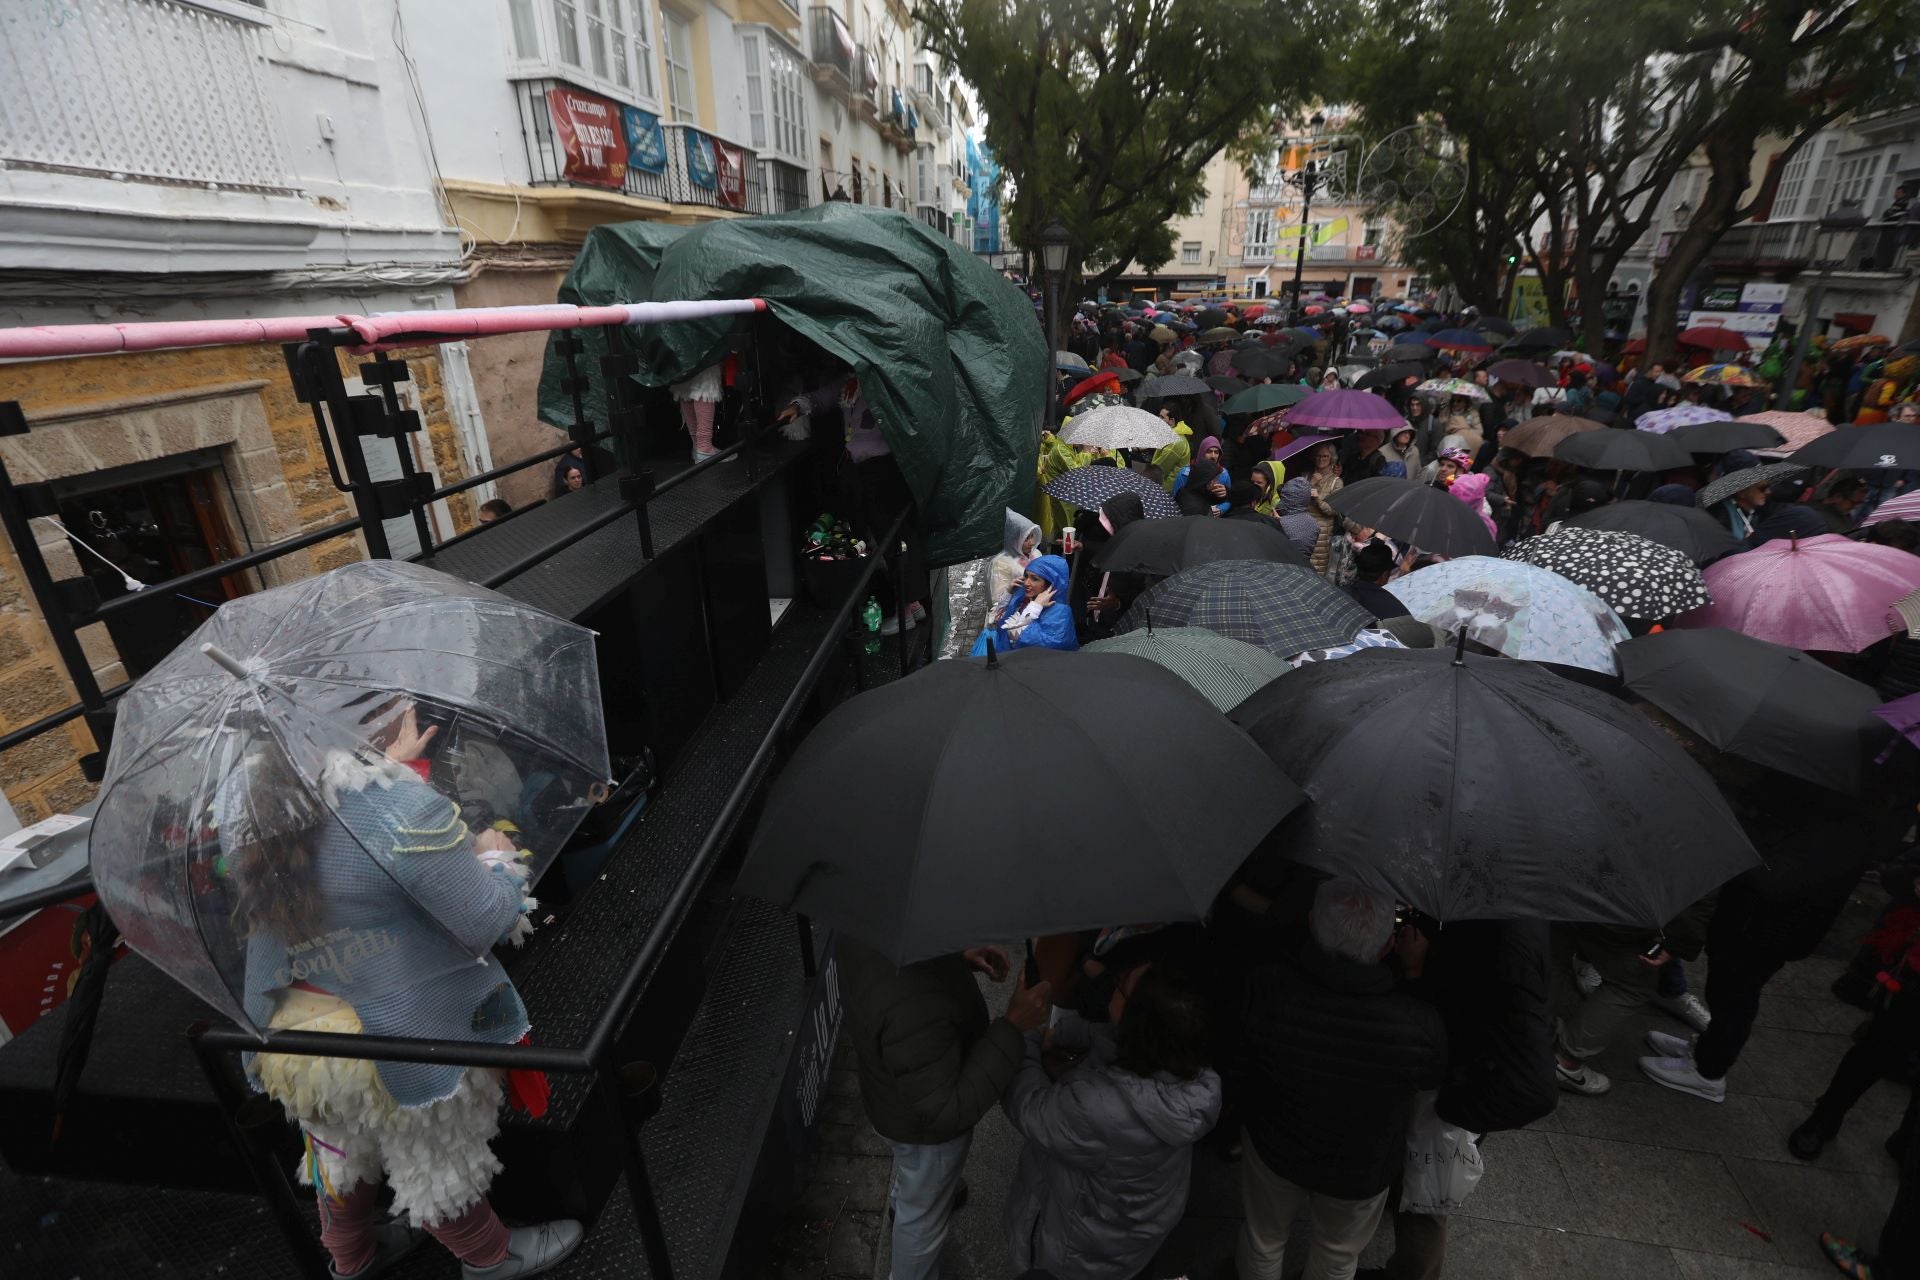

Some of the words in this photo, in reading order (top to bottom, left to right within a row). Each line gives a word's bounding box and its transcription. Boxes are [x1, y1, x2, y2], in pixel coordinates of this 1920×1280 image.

[567, 93, 607, 119] Cruzcampo
[286, 940, 314, 956] RAIN
[312, 937, 326, 948] IS
[325, 927, 353, 943] JUST
[274, 929, 399, 987] confetti
